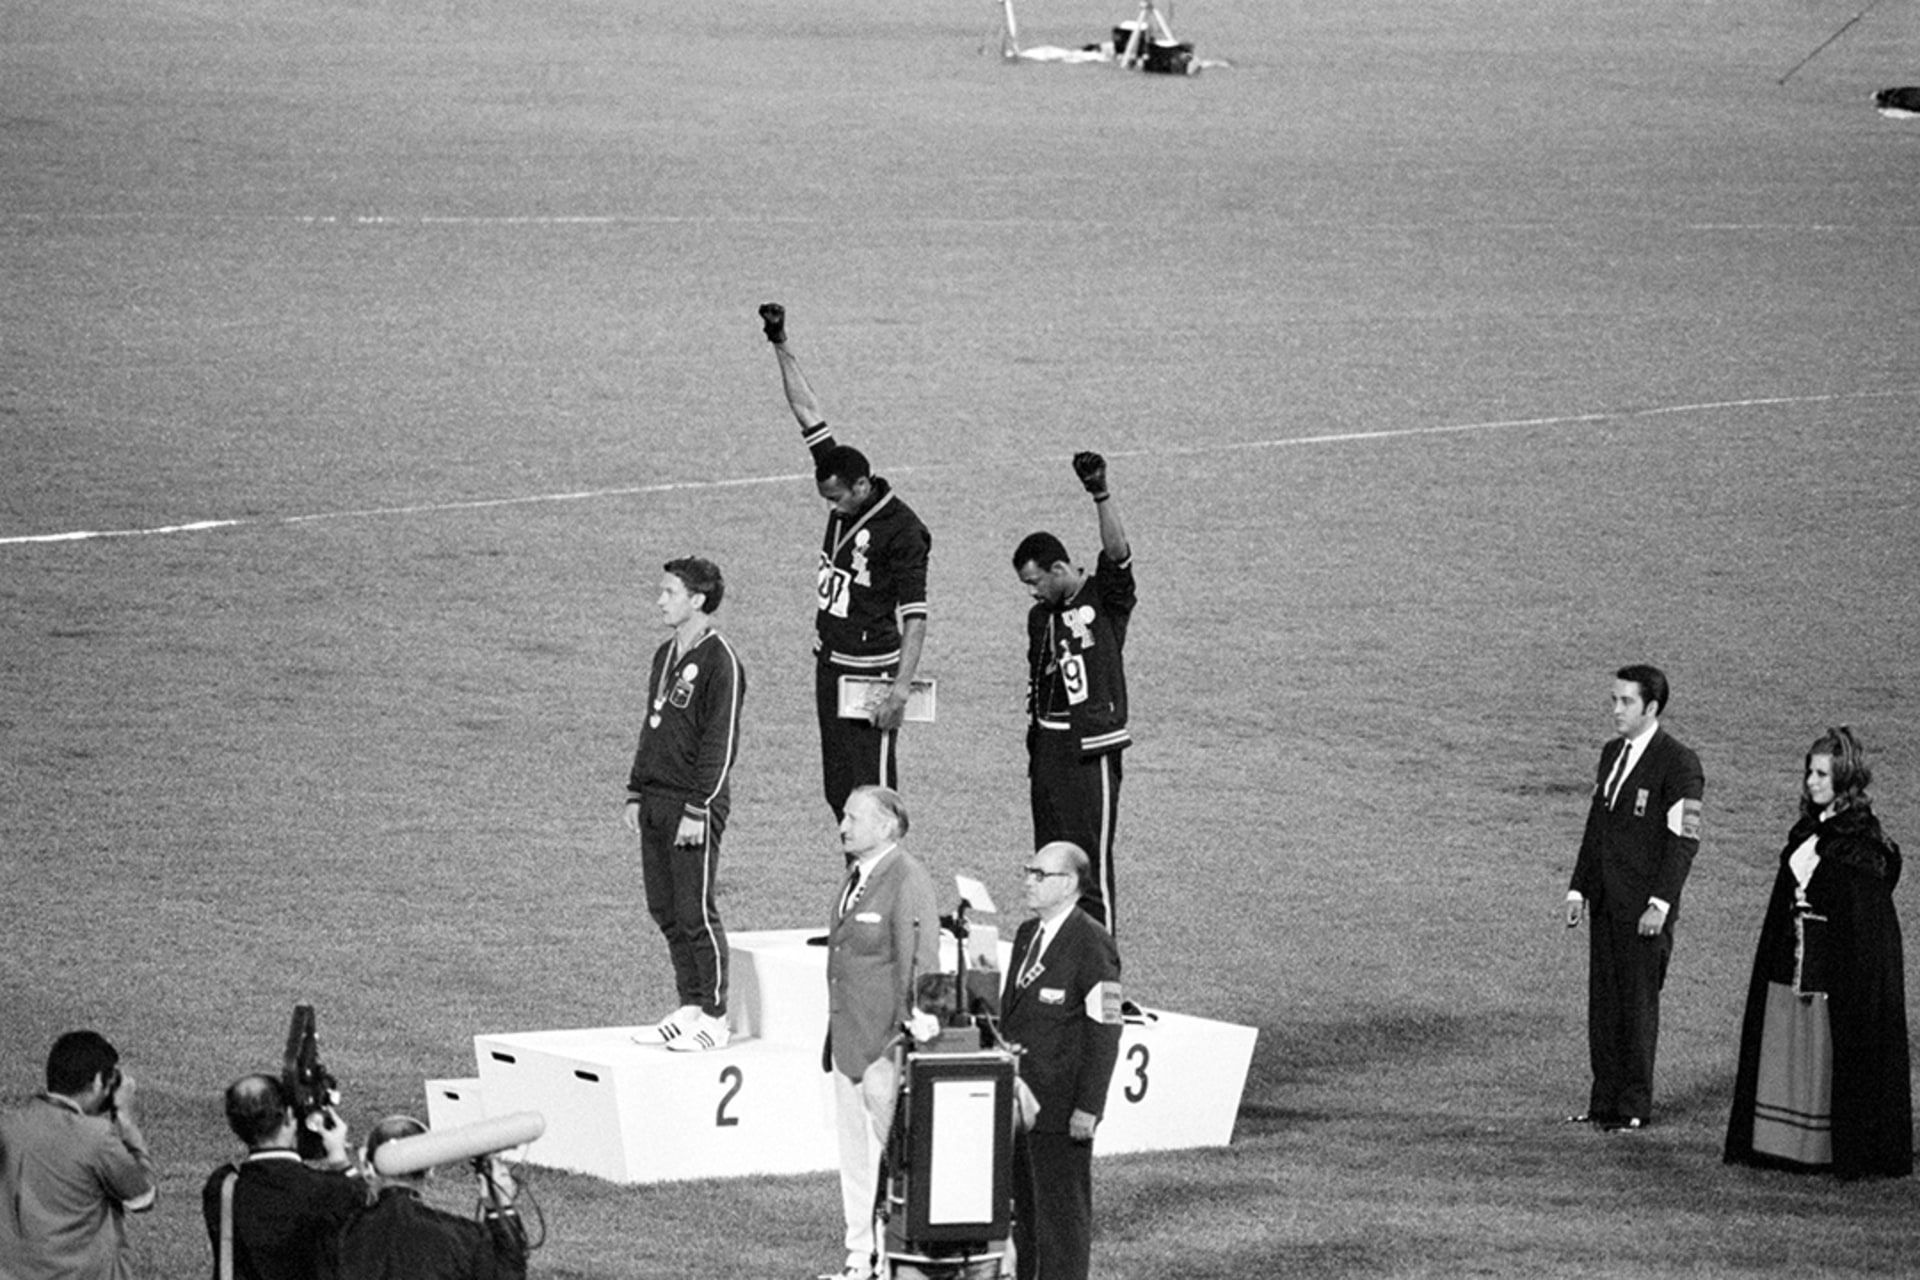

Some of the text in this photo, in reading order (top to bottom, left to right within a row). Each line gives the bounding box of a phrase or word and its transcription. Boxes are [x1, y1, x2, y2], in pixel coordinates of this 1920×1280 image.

[1064, 659, 1083, 694] 9
[716, 1065, 743, 1126] 2
[1124, 1043, 1150, 1104] 3
